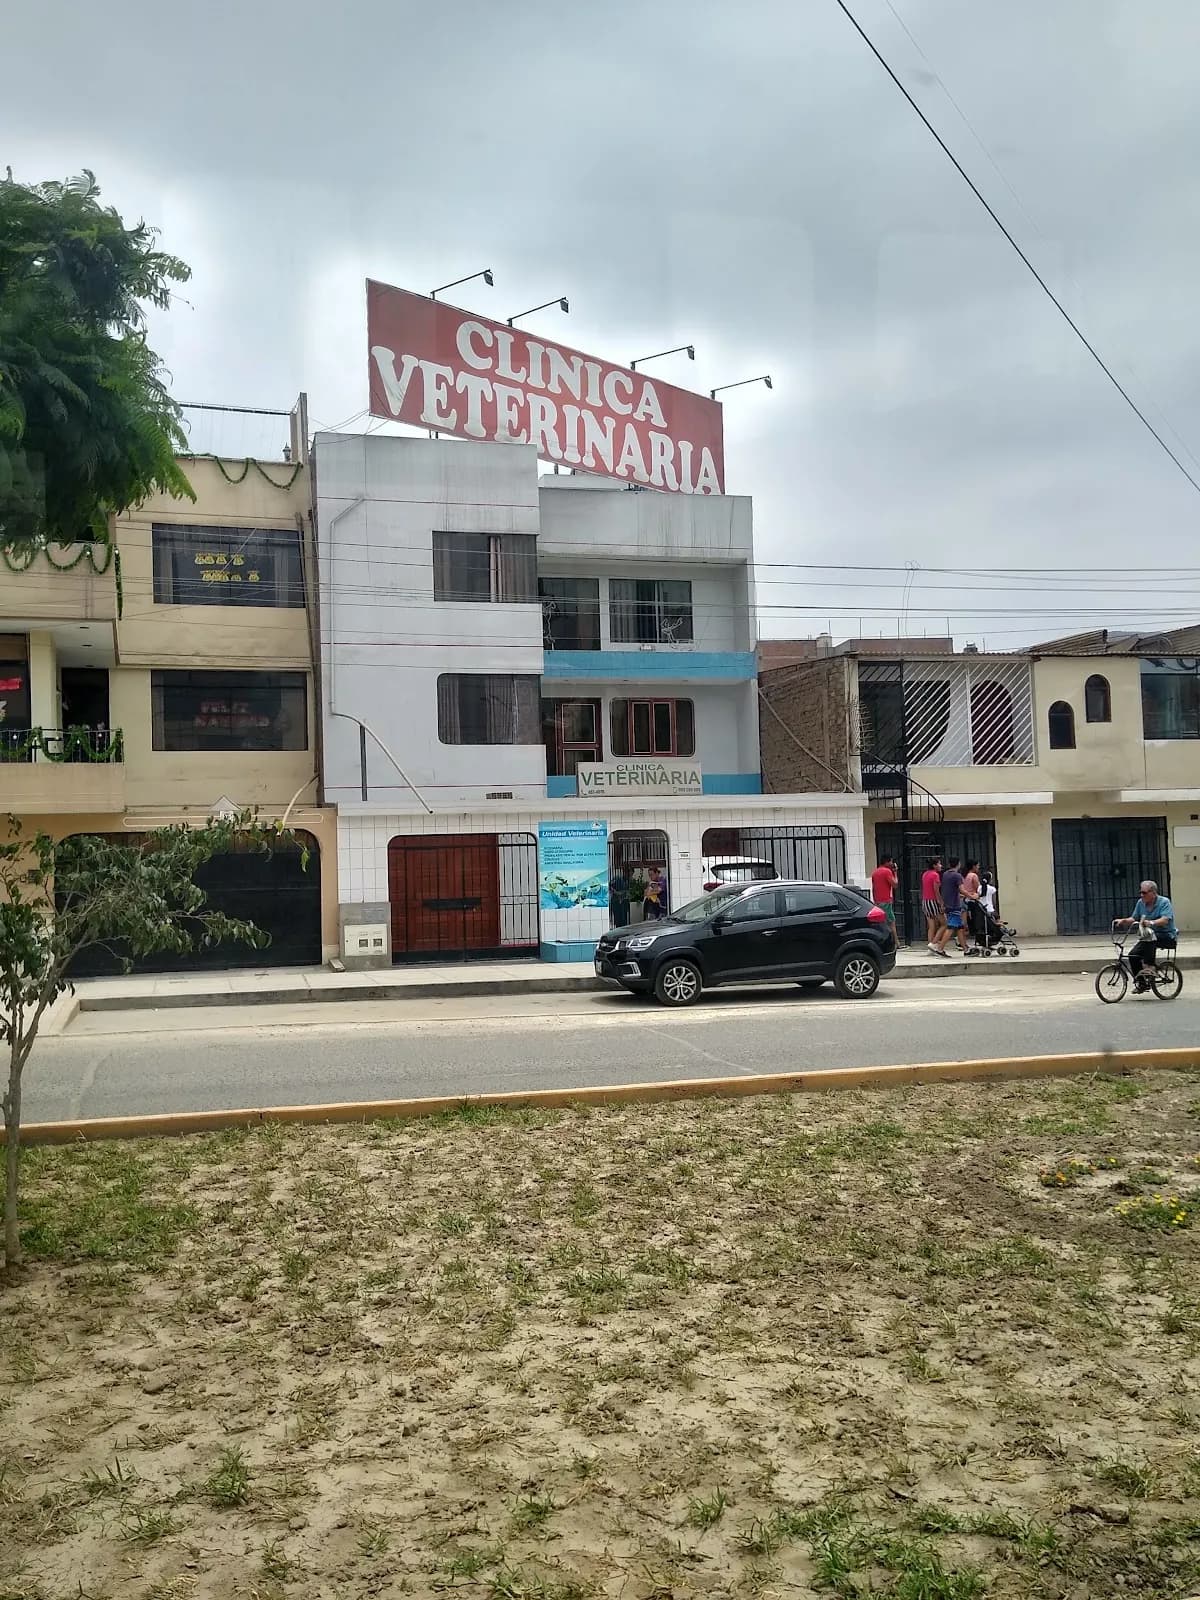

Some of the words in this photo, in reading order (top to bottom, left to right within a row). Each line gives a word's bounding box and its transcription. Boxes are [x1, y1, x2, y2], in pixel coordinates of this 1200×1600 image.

[456, 320, 668, 428] CLINICA
[371, 345, 721, 496] VETERINARIA
[581, 771, 700, 786] VETERINARIA
[616, 764, 665, 772] CLINICA
